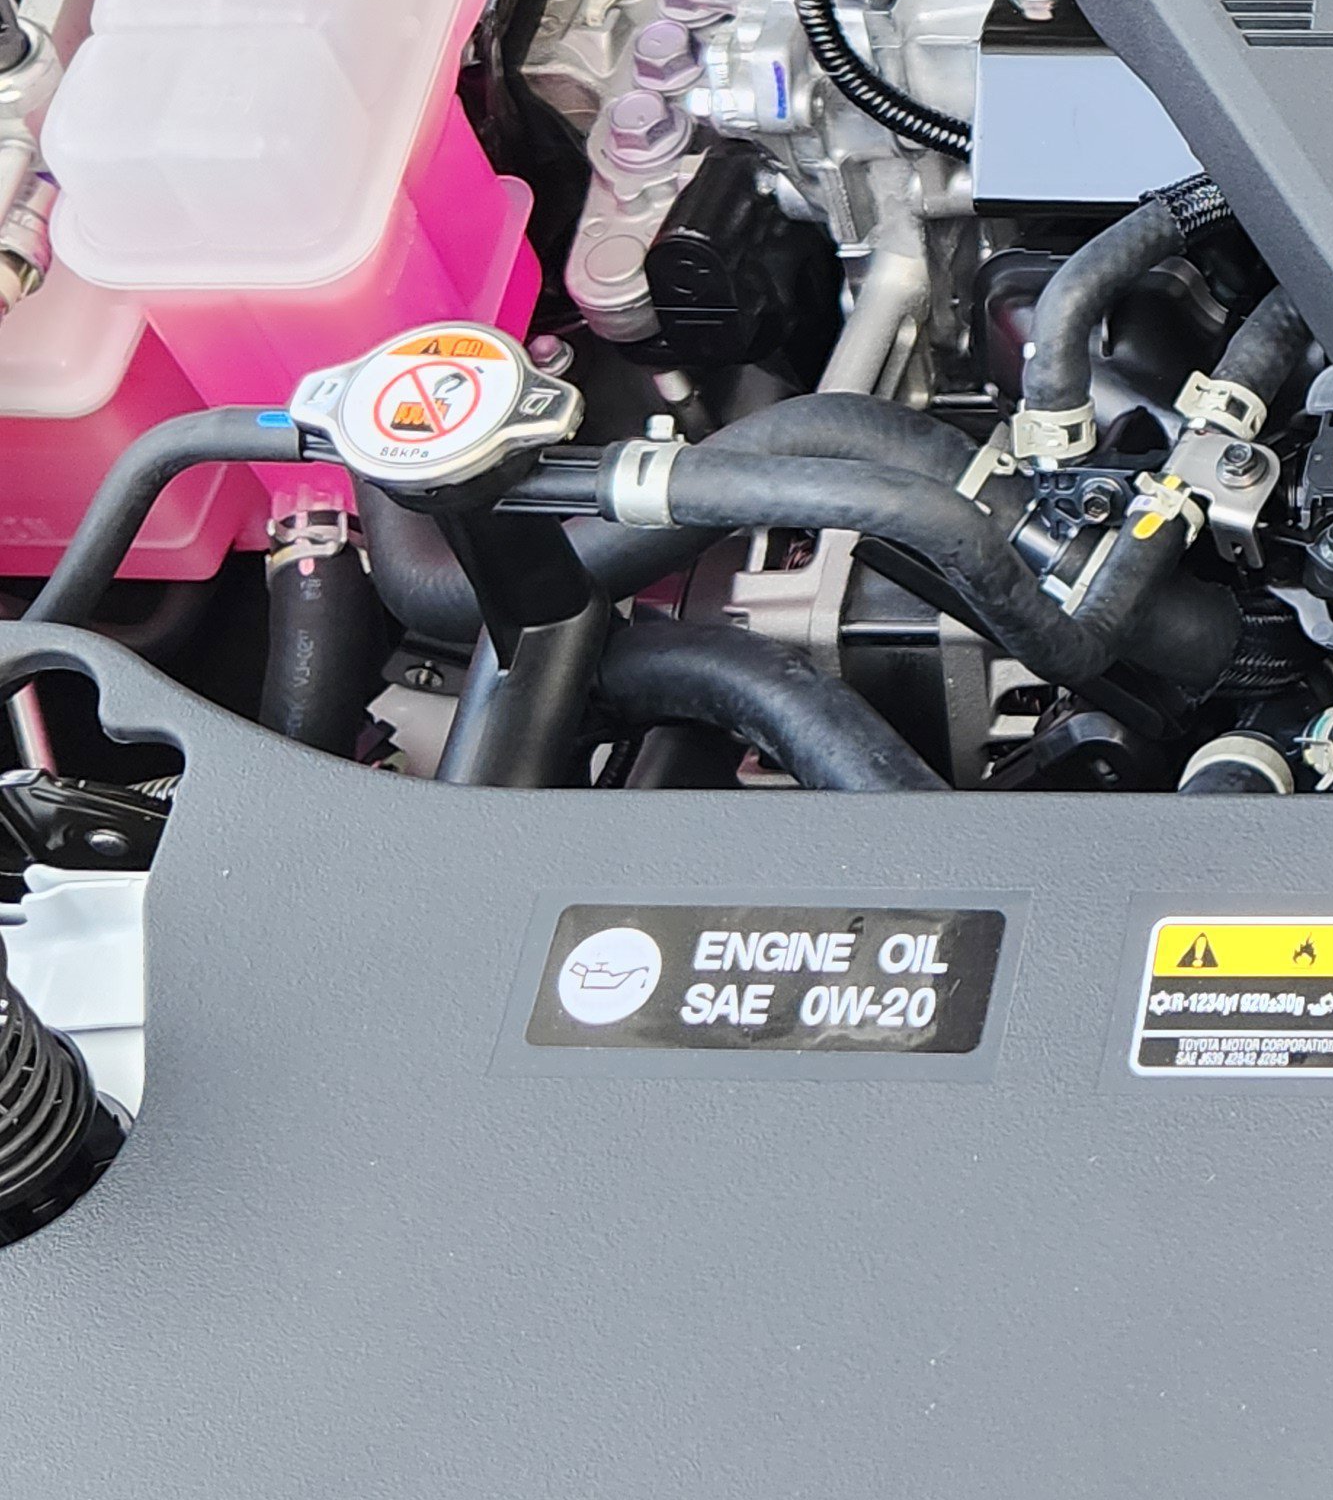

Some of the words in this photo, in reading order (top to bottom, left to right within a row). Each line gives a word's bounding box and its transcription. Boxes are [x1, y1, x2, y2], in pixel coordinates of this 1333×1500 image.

[693, 930, 856, 974] ENGINE
[877, 932, 950, 975] OIL
[680, 982, 776, 1027] SAE
[800, 984, 940, 1029] 0W-20
[1174, 1051, 1198, 1066] SAE
[1178, 1038, 1220, 1052] TOYOTA
[1220, 1038, 1260, 1052] MOTOR
